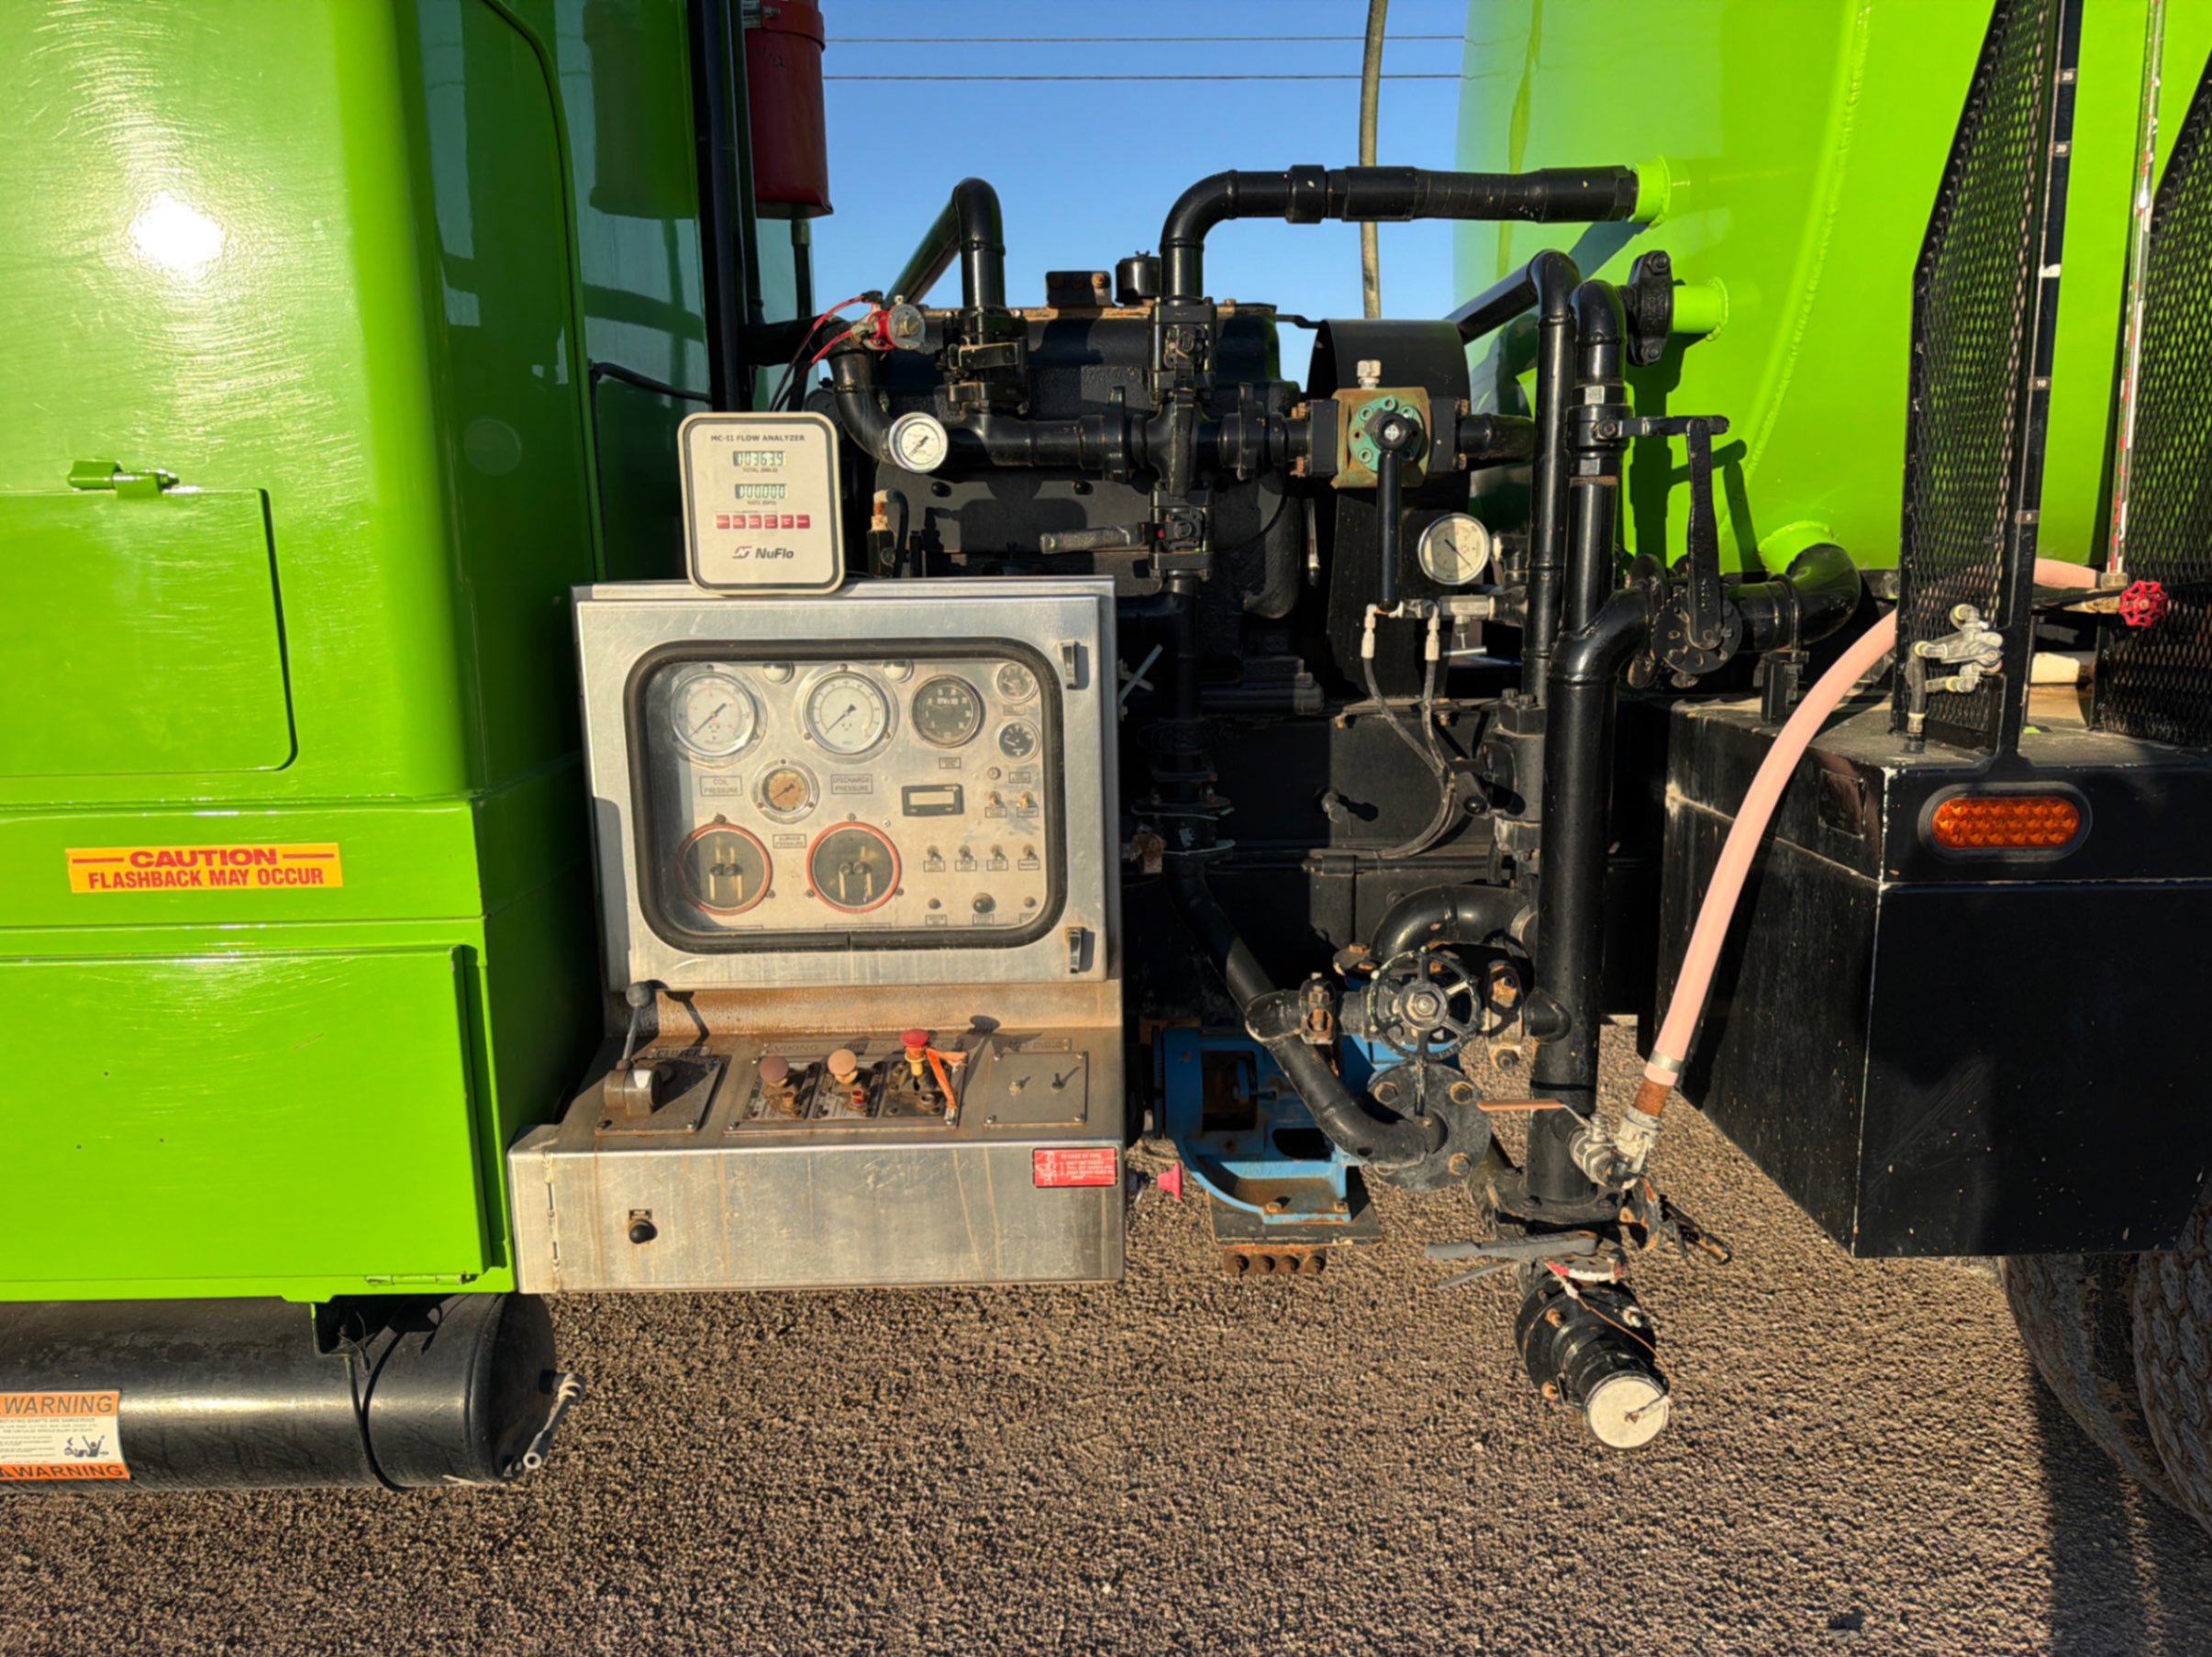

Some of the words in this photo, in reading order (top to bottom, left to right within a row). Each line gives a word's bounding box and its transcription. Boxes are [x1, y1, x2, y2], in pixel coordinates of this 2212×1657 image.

[755, 548, 795, 559] NuFlo
[129, 849, 277, 868] CAUTION
[89, 868, 202, 889] FLASHBACK
[209, 868, 249, 886] MAY
[258, 867, 324, 885] OCCUR
[5, 1396, 113, 1414] WARNING
[12, 1464, 124, 1478] WARNING
